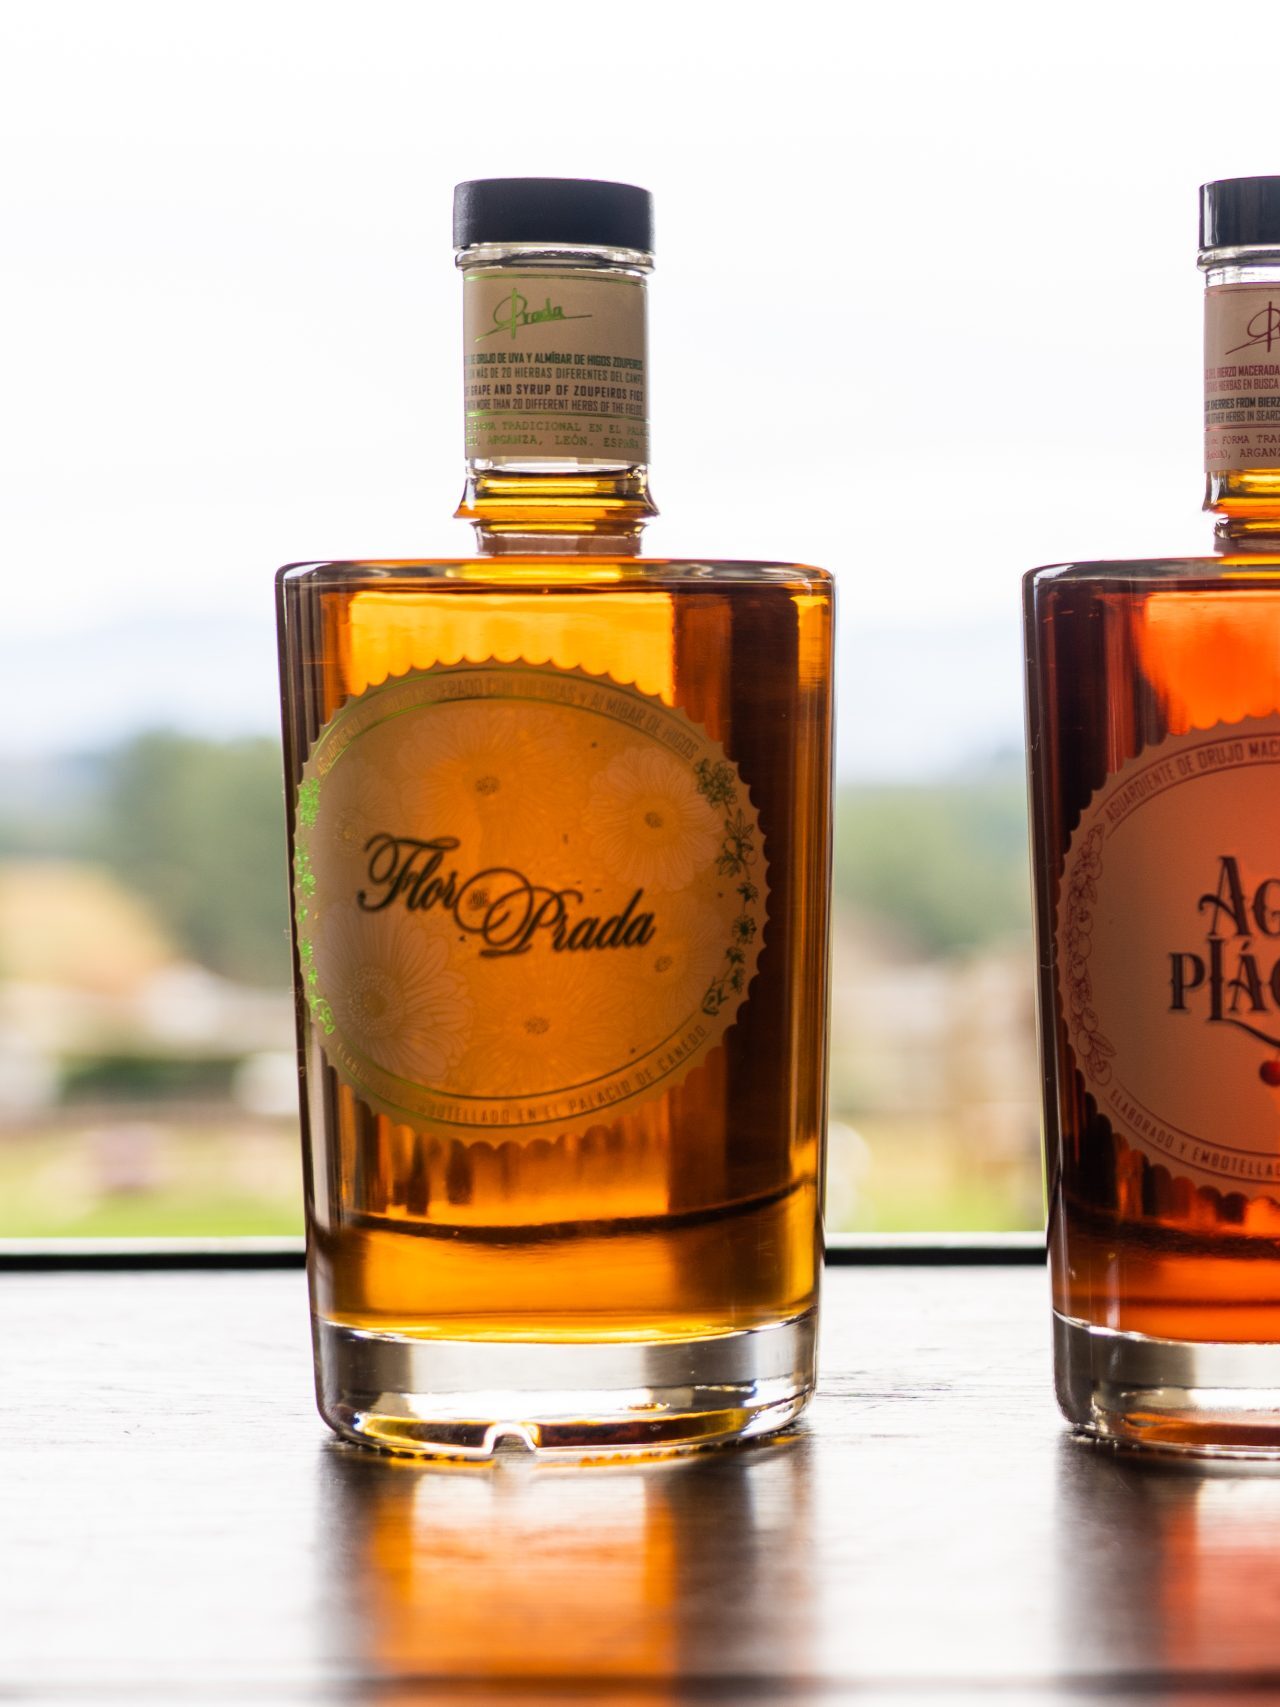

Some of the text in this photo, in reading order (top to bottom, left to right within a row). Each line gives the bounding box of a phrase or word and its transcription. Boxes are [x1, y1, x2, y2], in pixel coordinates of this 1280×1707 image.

[497, 352, 508, 364] DE
[508, 352, 525, 364] UVA
[526, 352, 532, 363] Y
[534, 350, 573, 365] ALMÍBAR
[574, 353, 585, 365] DE
[586, 354, 611, 367] HIGOS
[489, 367, 499, 379] DE
[501, 367, 512, 379] 20
[514, 367, 553, 379] HIERBAS
[556, 368, 608, 382] DIFERENTES
[610, 370, 624, 383] DEL
[1243, 378, 1253, 390] EN
[1253, 377, 1280, 390] BUSCA
[494, 384, 512, 396] AND
[516, 384, 551, 396] SYRUP
[555, 384, 569, 396] OF
[574, 385, 627, 399] ZOUPEIROS
[493, 398, 511, 410] THAN
[512, 399, 523, 410] 20
[525, 398, 569, 410] DIFFERENT
[571, 399, 598, 412] HERBS
[600, 400, 610, 413] OF
[612, 402, 625, 413] THE
[1236, 396, 1257, 408] FROM
[1226, 411, 1246, 422] HERBS
[1246, 410, 1255, 422] IN
[502, 421, 581, 433] TRADICIONAL
[588, 423, 603, 434] EN
[609, 423, 622, 435] EL
[1222, 434, 1250, 445] FORMA
[1104, 762, 1176, 823] AGUARDIENTE
[1176, 754, 1194, 776] DE
[1196, 742, 1245, 771] ORUJO
[356, 832, 462, 914] Flor
[453, 866, 659, 959] Prada
[568, 1078, 632, 1111] PALACIO
[635, 1068, 657, 1087] DE
[657, 1024, 707, 1072] CANEDO
[1109, 1088, 1176, 1150] ELABORADO
